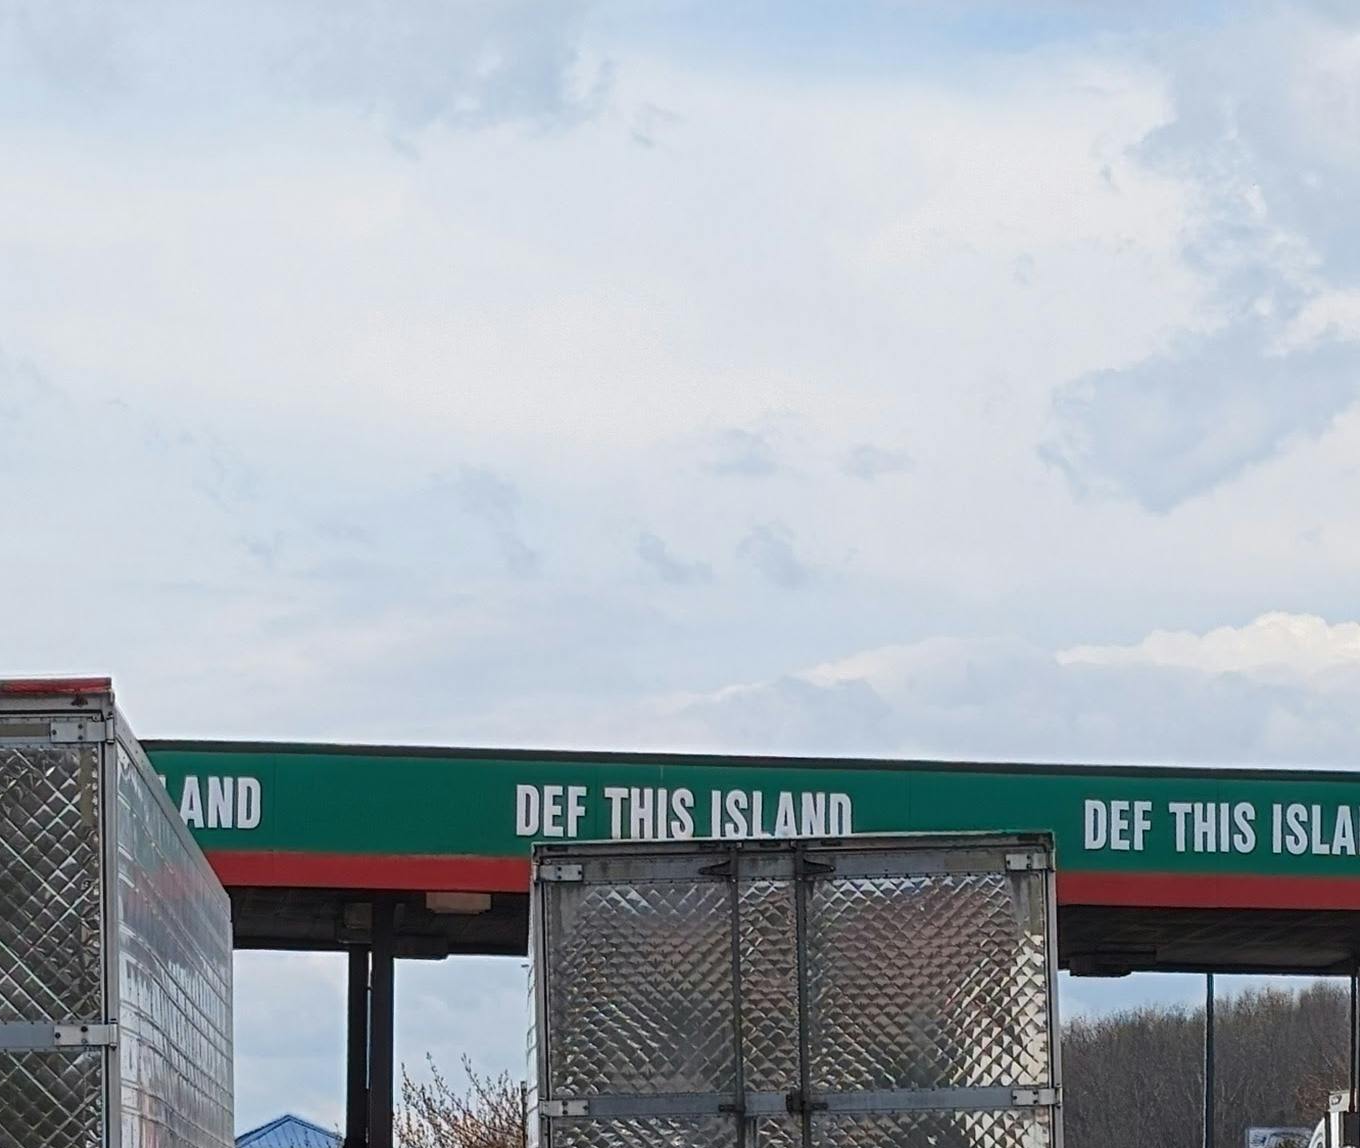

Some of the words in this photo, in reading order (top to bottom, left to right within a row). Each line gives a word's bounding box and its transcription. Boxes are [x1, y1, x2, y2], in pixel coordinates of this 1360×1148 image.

[516, 784, 587, 837] DEF
[604, 787, 694, 840] THIS
[711, 789, 852, 839] ISLAND
[1084, 799, 1152, 851] DEF
[1169, 802, 1256, 854] THIS
